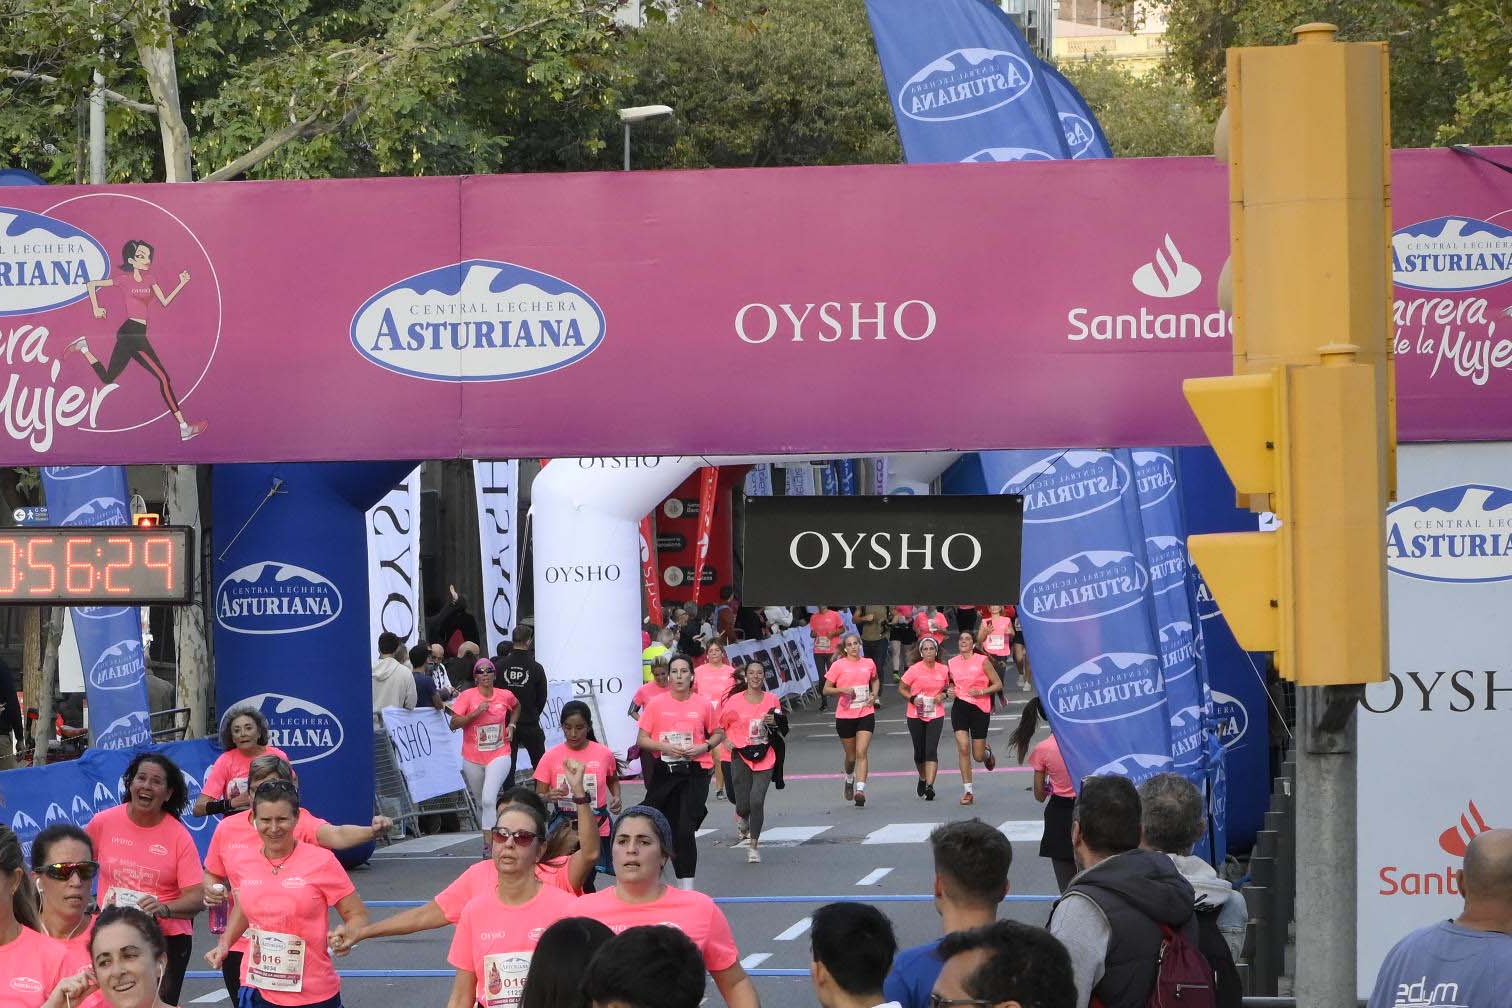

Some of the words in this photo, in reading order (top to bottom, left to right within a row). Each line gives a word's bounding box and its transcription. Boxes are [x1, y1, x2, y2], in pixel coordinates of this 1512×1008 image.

[13, 243, 85, 256] LECHERA
[409, 303, 487, 315] CENTRAL
[496, 300, 577, 312] LECHERA
[1392, 297, 1488, 326] arrera
[370, 307, 585, 352] ASTURIANA
[734, 300, 937, 344] OYSHO
[1416, 327, 1434, 354] la
[1430, 321, 1512, 386] Muje
[1414, 519, 1481, 529] CENTRAL
[789, 530, 982, 572] OYSHO
[545, 563, 621, 585] OYSHO
[232, 586, 275, 594] CENTRAL
[279, 586, 329, 594] LECHERA
[220, 590, 333, 619] ASTURIANA
[510, 671, 523, 680] BP
[575, 676, 623, 696] SHO
[280, 717, 330, 726] LECHERA
[269, 728, 334, 747] RIANA
[1379, 866, 1459, 896] Sant
[262, 954, 281, 964] 016
